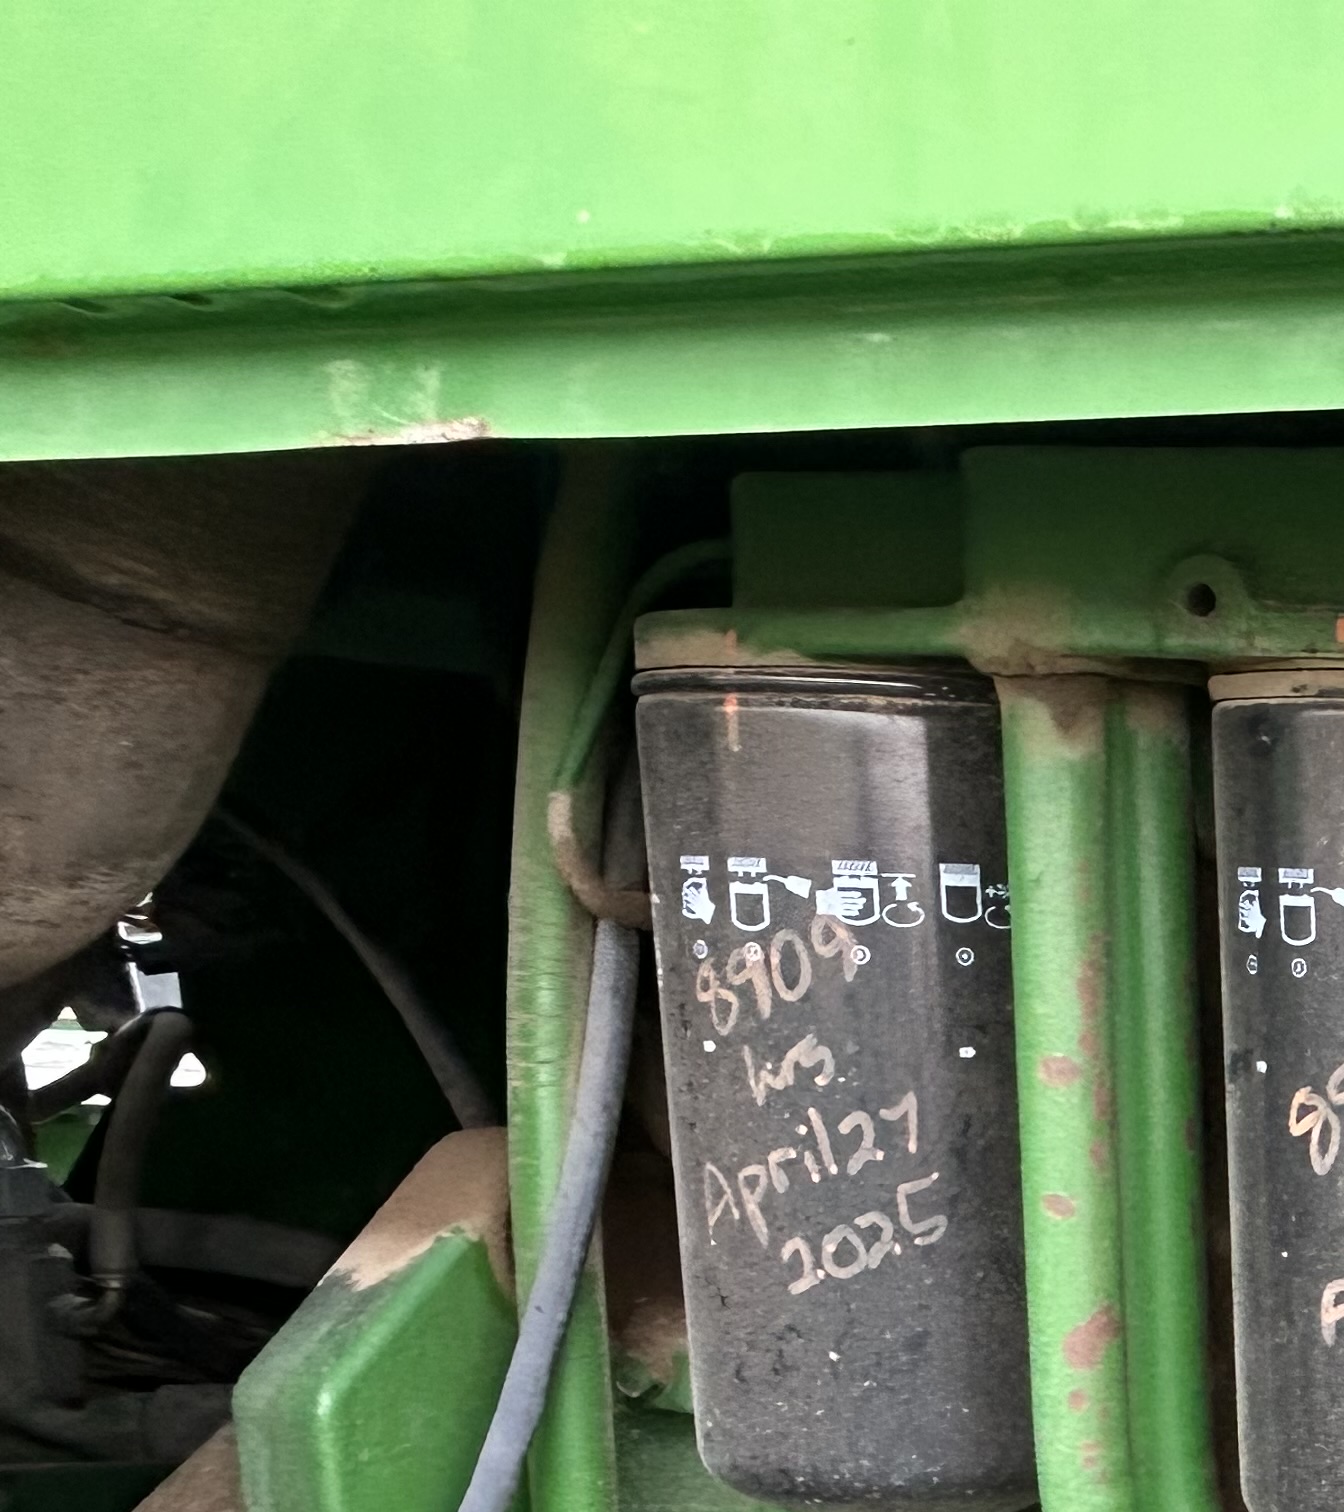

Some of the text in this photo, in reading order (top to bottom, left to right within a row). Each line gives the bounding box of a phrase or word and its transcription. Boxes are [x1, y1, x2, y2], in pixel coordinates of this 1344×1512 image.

[695, 915, 858, 1036] 8909
[705, 1091, 918, 1247] April 27
[781, 1173, 948, 1294] 2025
